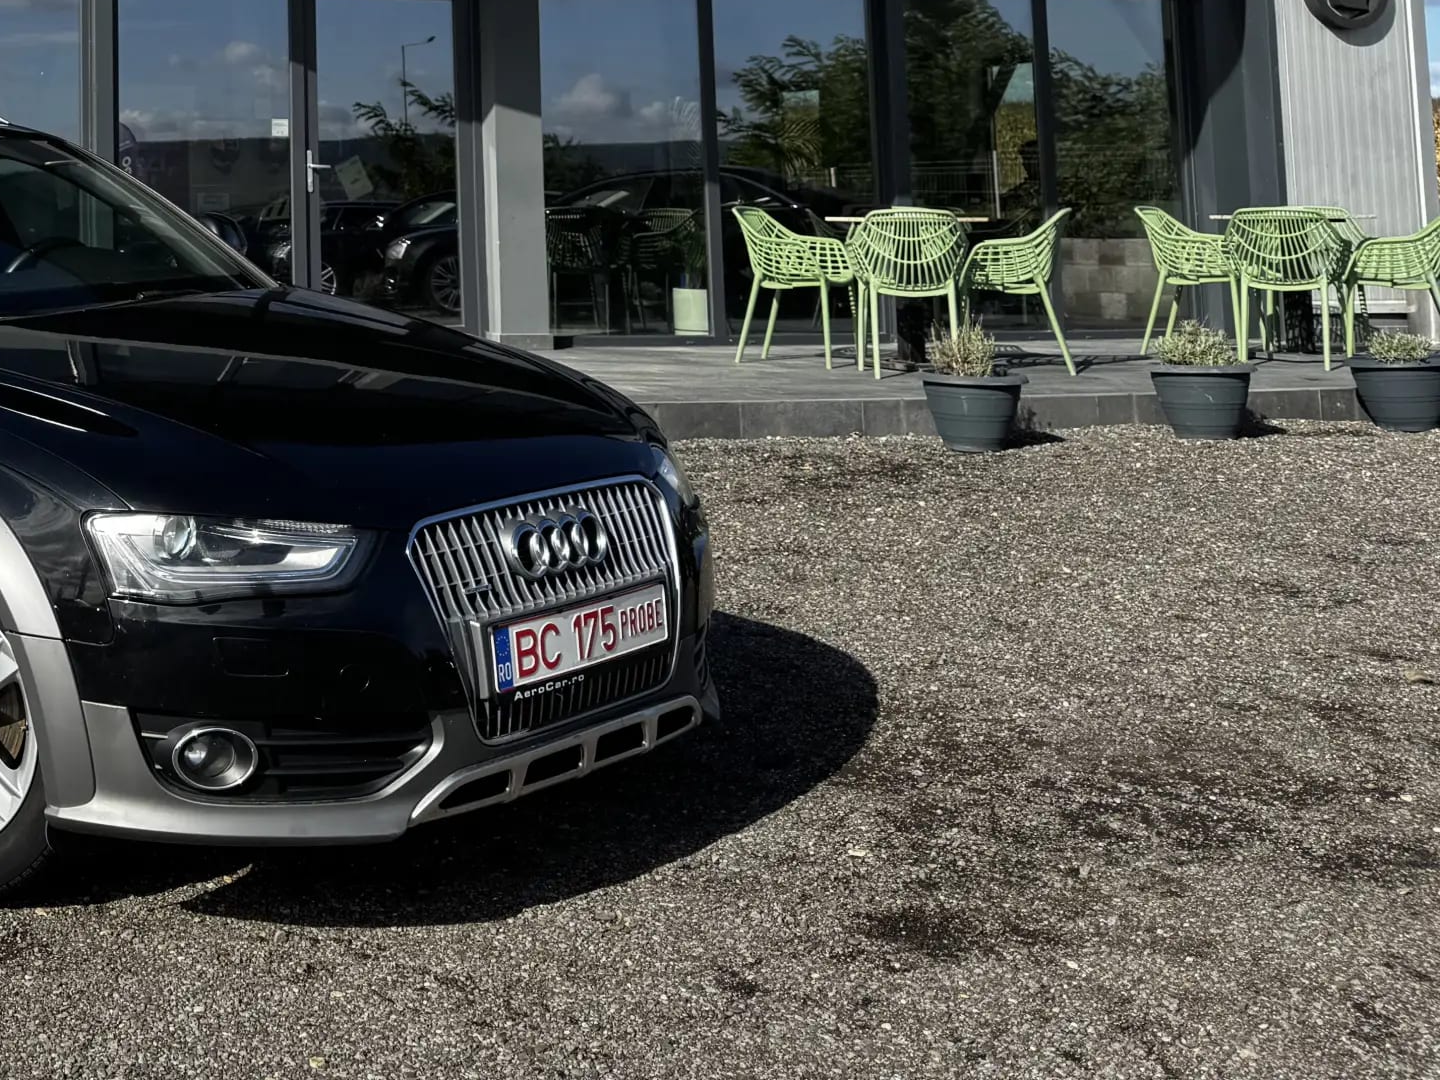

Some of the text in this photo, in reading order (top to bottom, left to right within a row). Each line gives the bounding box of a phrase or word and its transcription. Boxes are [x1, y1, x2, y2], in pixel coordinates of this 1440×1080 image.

[514, 598, 663, 679] BC 175 PROBE
[514, 674, 585, 701] AeroCar.ro
